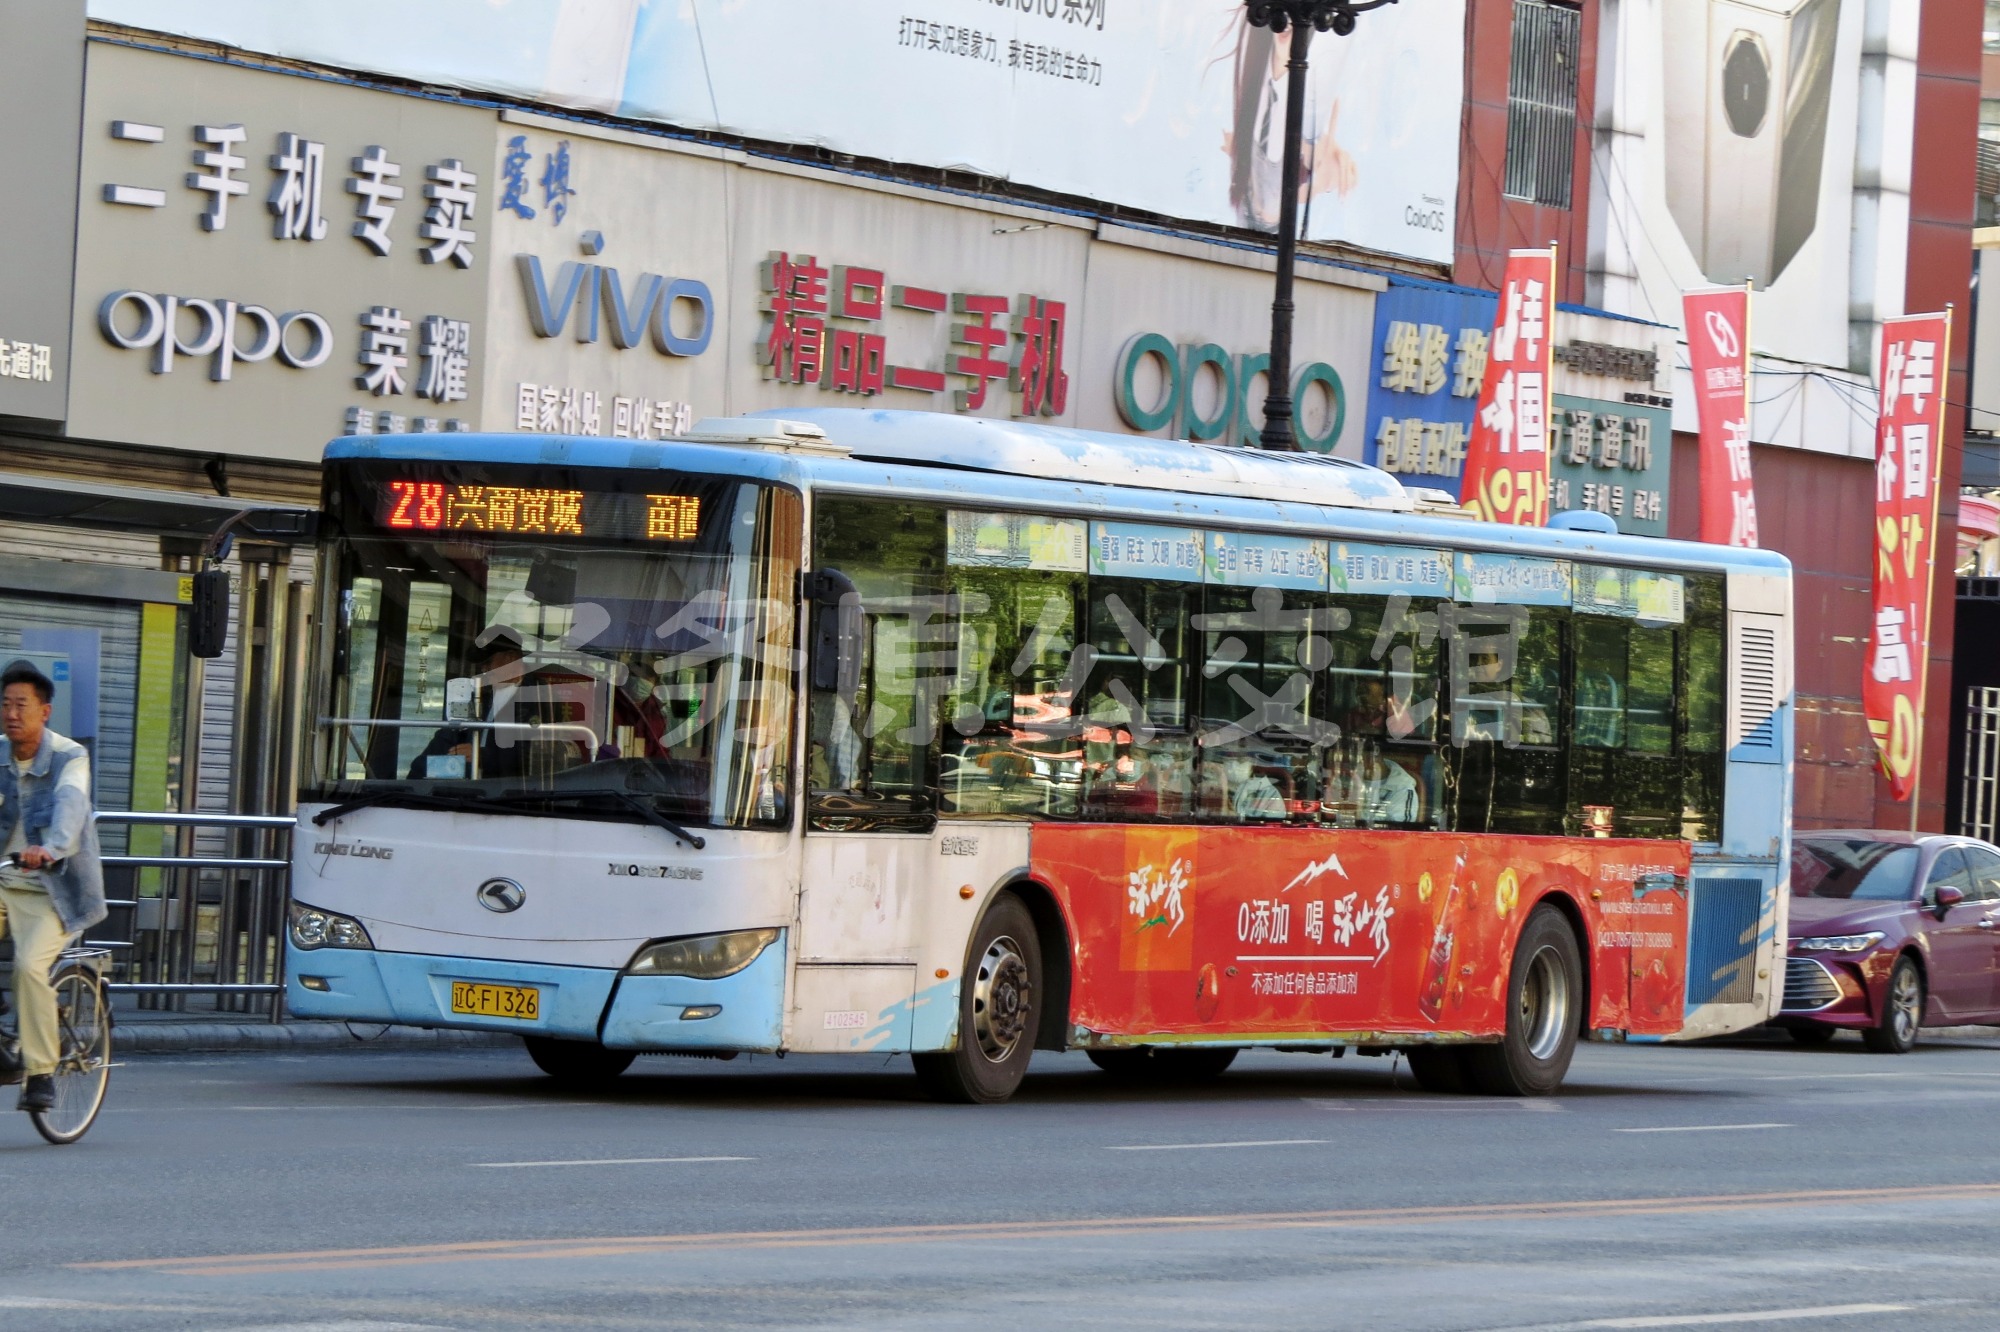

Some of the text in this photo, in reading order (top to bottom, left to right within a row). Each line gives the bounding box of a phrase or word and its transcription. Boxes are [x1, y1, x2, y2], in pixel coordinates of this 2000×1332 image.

[104, 119, 478, 269] 二手机专卖
[1404, 205, 1444, 232] ColorOS
[355, 305, 471, 402] 荣耀
[756, 250, 1069, 417] 精品二手机
[1381, 320, 1449, 396] 维修
[517, 382, 693, 440] 国家补贴 回收手机
[388, 480, 443, 529] 28
[446, 484, 585, 535] 兴商贸城
[1582, 483, 1624, 516] 手机号
[1633, 489, 1662, 521] 配件
[1100, 535, 1120, 562] 富强
[1126, 537, 1145, 565] 民主
[1150, 539, 1170, 567] 文明
[1175, 541, 1196, 569] 和谐
[1217, 546, 1316, 578] 自由 平等 公正 法治
[1345, 554, 1438, 585] 爱国 敬业 诚信 友善
[314, 842, 394, 860] KING LONG
[1238, 898, 1290, 945] 0添加
[1305, 900, 1324, 945] 喝
[1251, 971, 1358, 995] 不添加任何食品添加剂
[825, 1011, 867, 1027] 4102545
